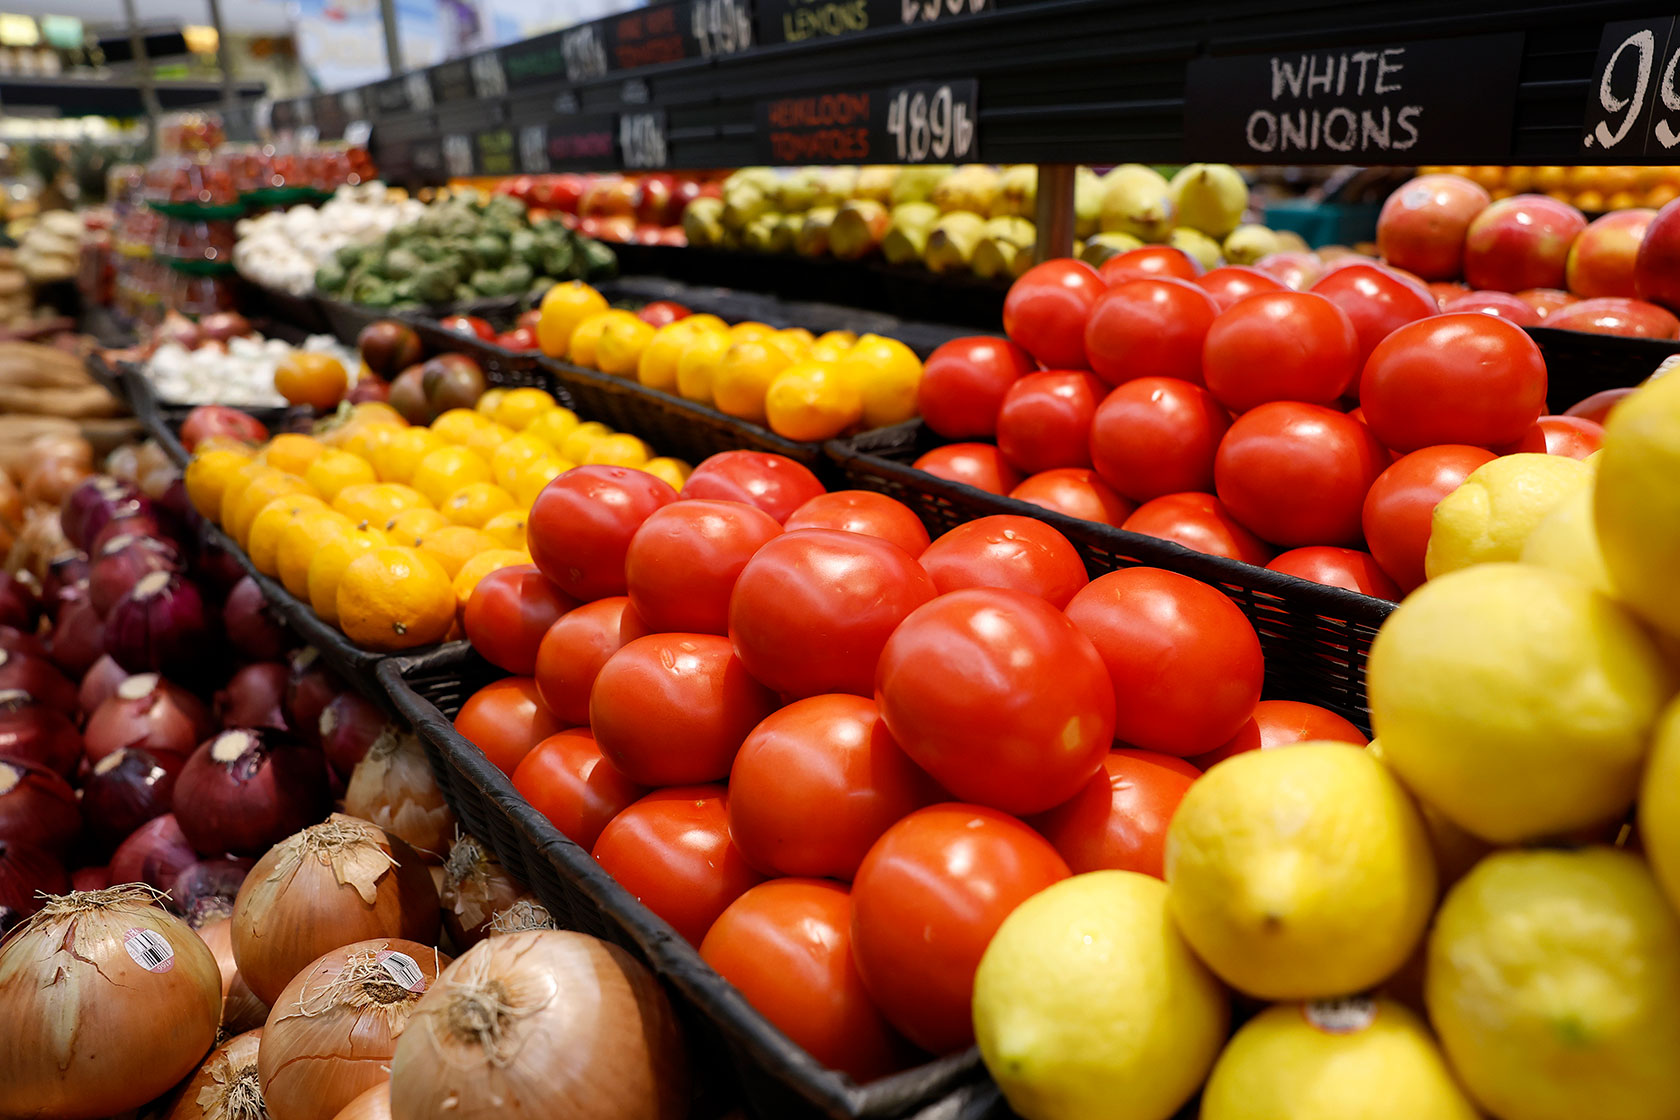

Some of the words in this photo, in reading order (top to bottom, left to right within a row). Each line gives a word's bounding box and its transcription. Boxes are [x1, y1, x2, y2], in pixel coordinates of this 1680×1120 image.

[783, 1, 868, 42] LEMONS
[1269, 48, 1406, 100] WHITE
[769, 128, 870, 161] TOMATOES
[1246, 105, 1424, 152] ONIONS
